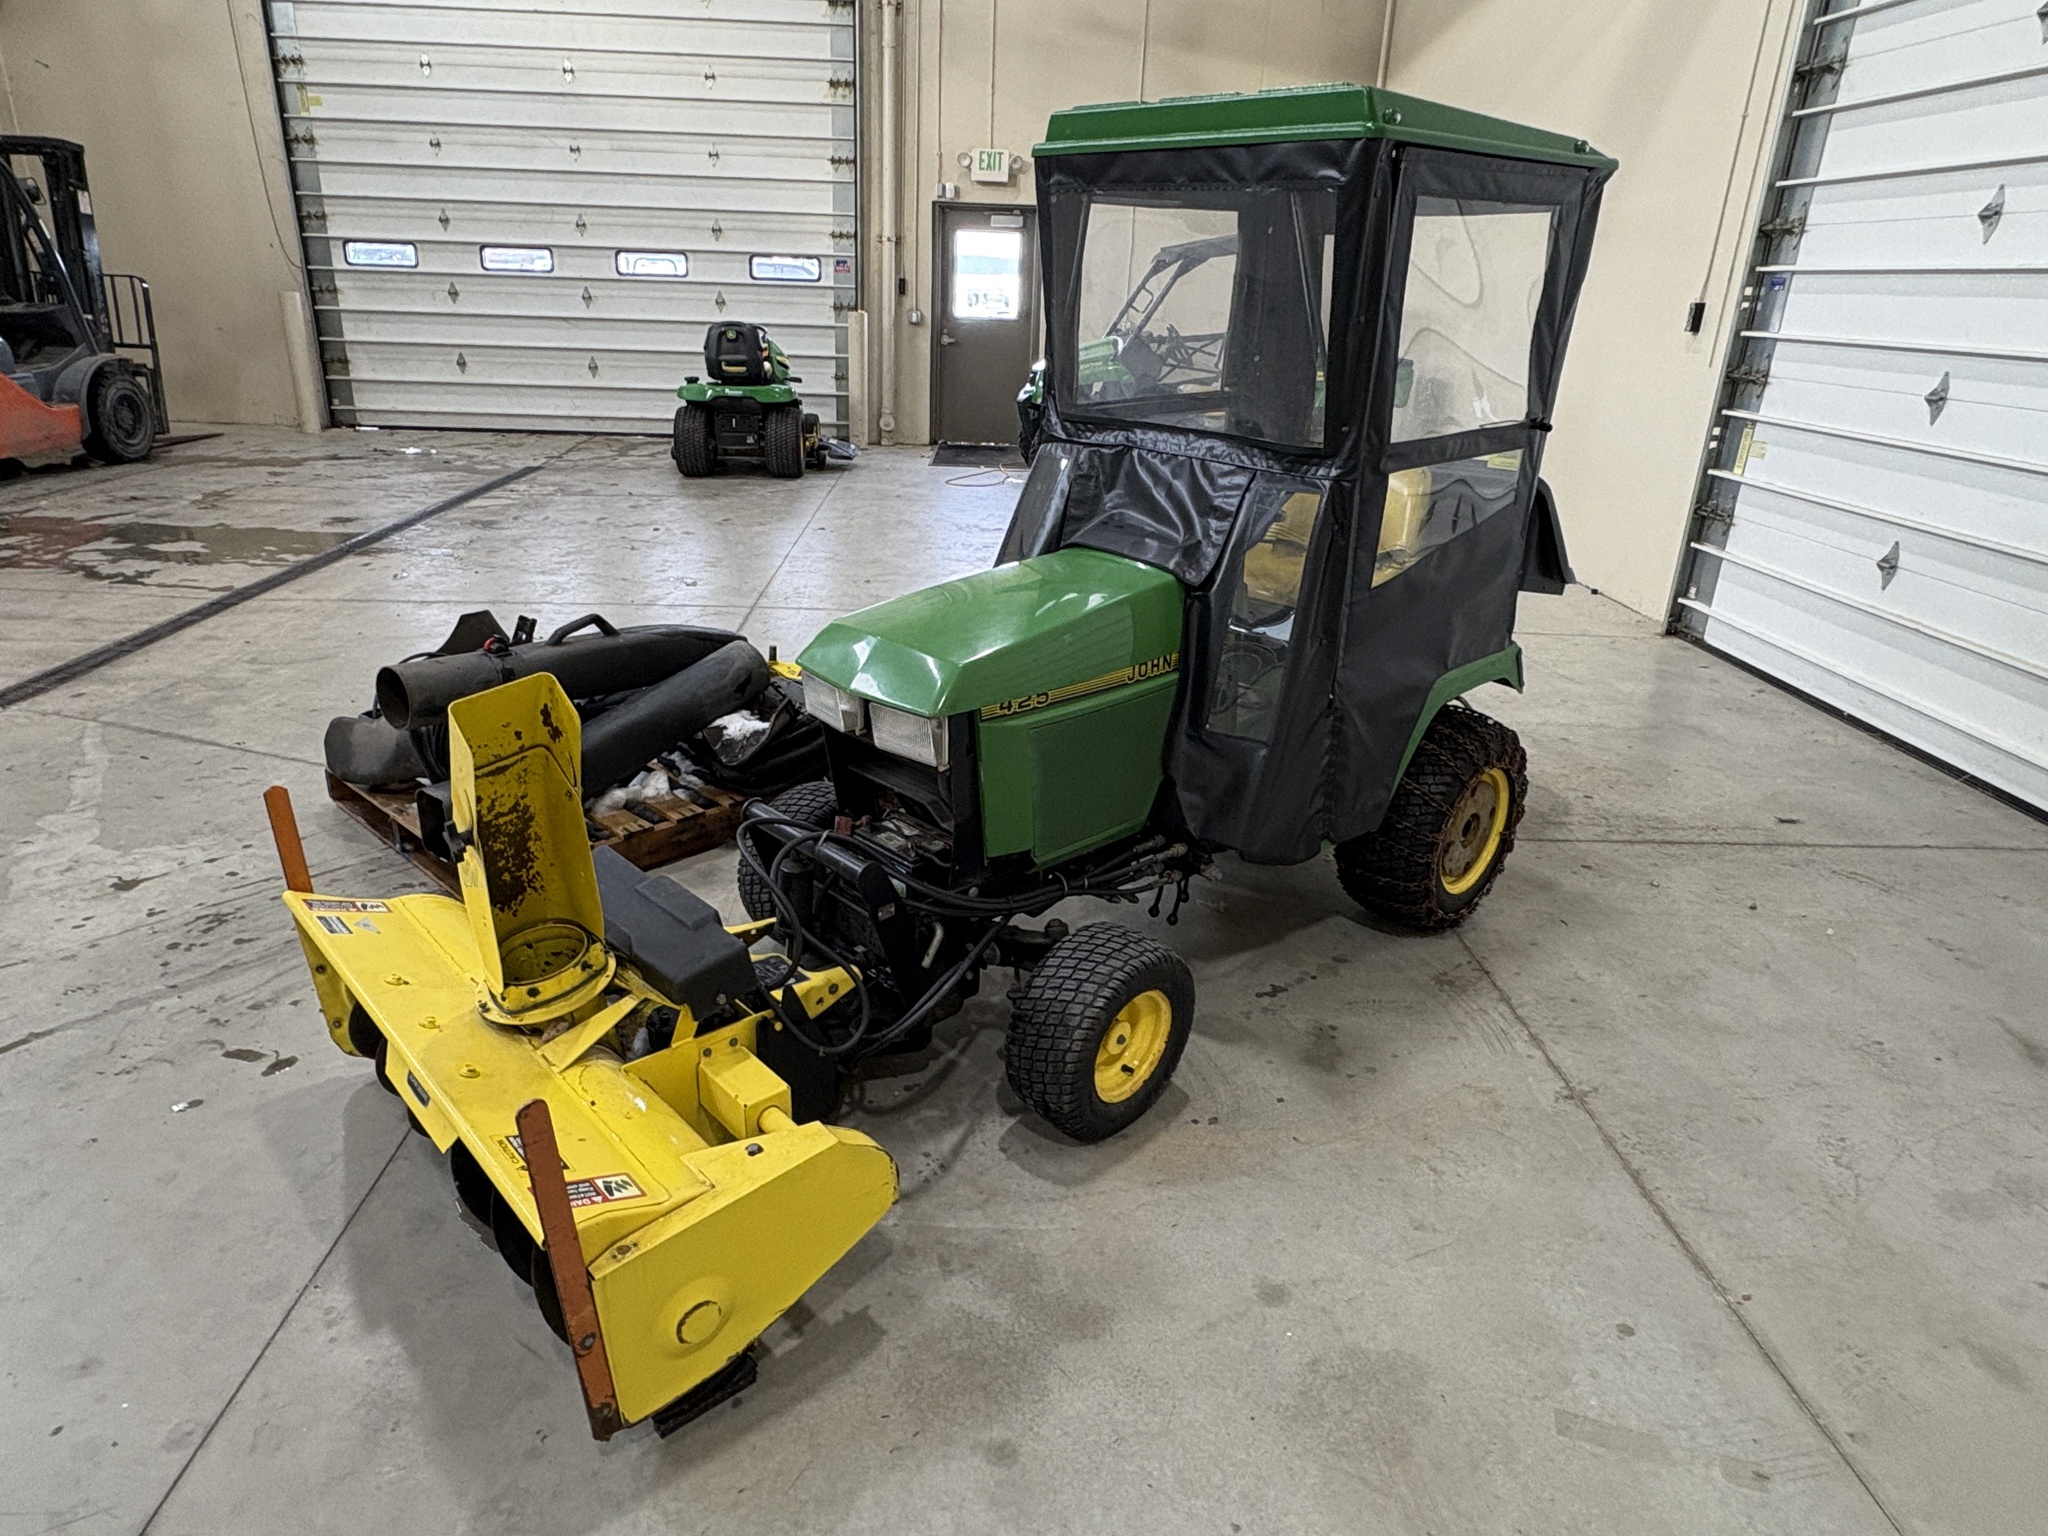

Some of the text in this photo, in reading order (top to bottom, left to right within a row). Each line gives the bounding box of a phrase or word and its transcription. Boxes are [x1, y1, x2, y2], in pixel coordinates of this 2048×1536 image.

[979, 150, 1004, 171] EXIT
[999, 653, 1172, 713] 425 JOHN
[497, 1139, 520, 1164] CAUTION
